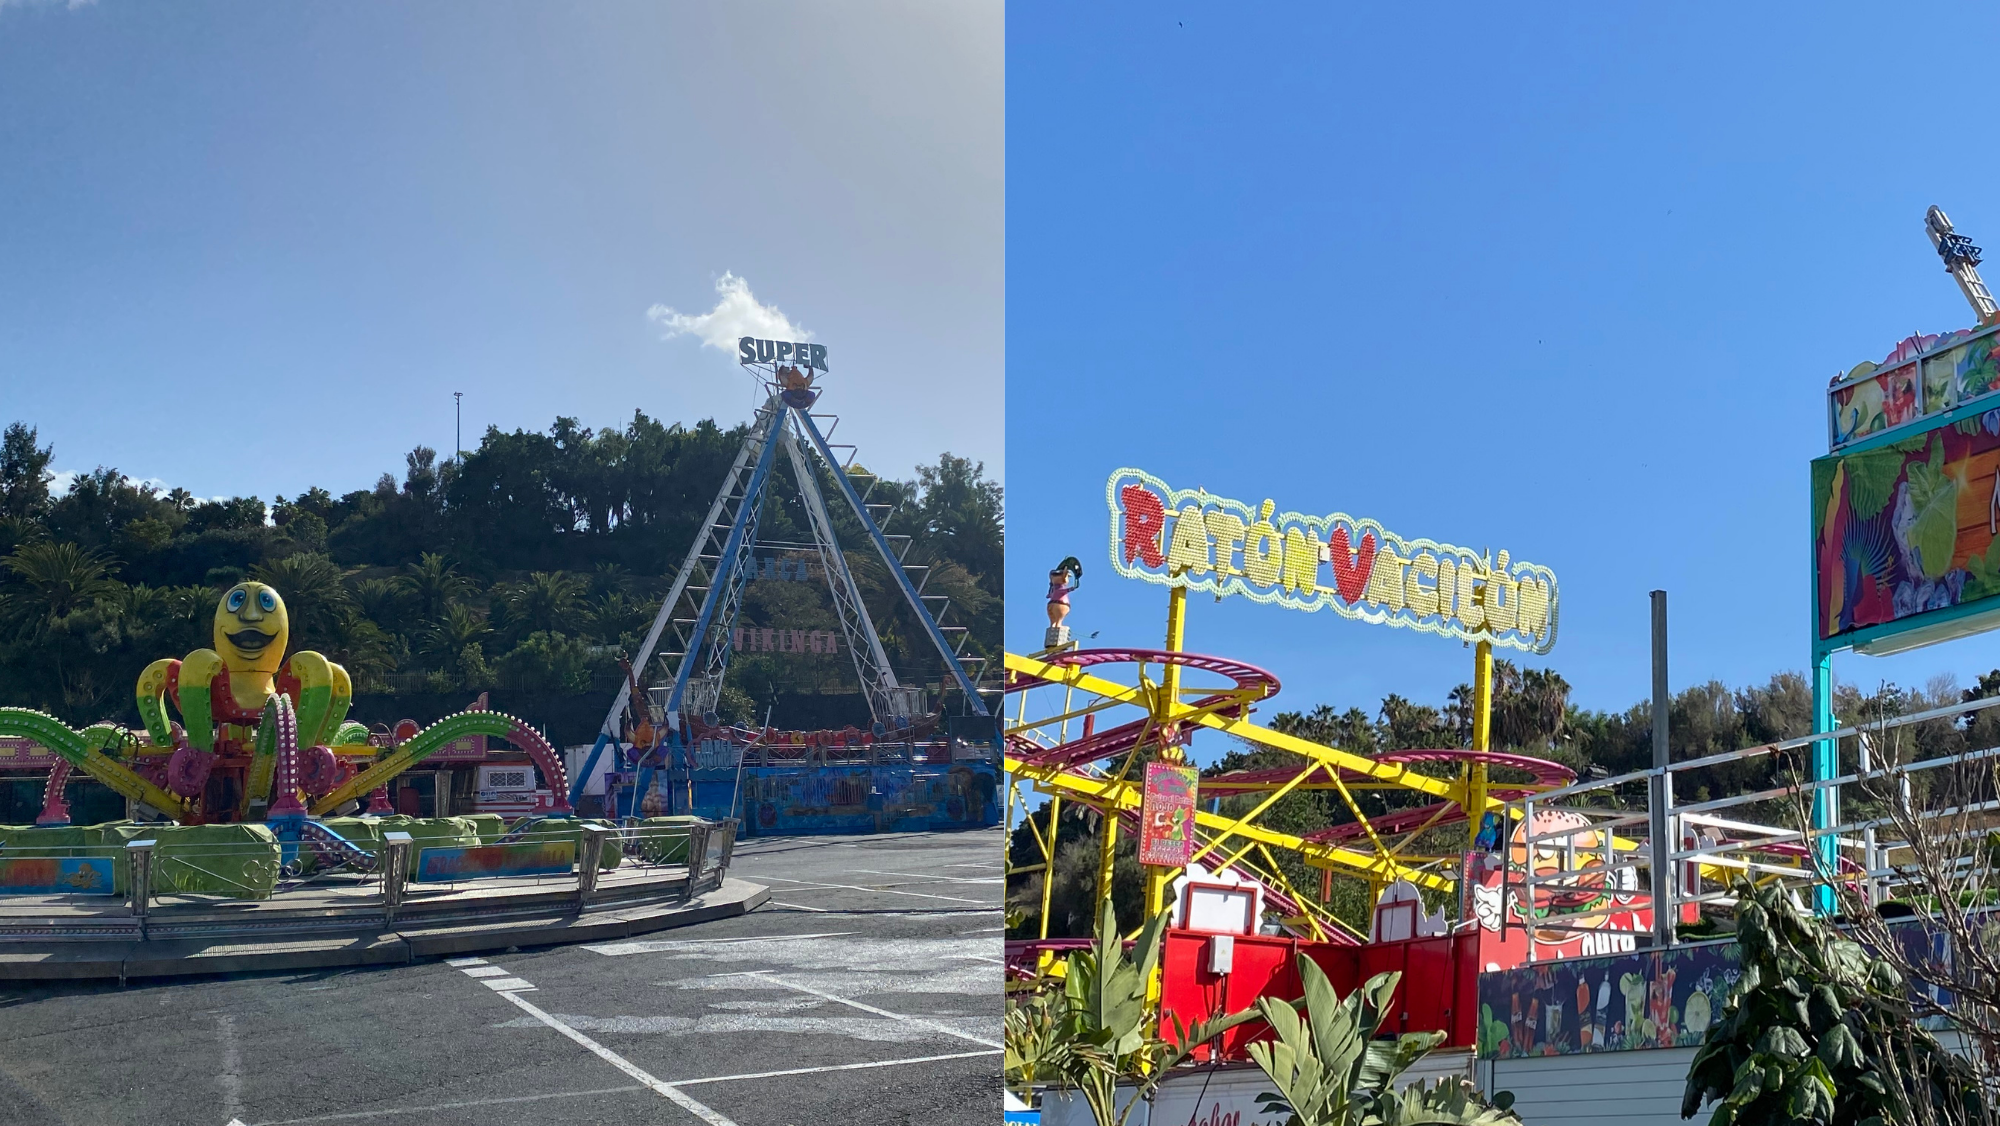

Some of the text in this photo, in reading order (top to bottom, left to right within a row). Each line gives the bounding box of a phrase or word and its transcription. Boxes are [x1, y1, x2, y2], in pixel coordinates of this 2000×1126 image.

[739, 336, 829, 372] SUPER
[1121, 484, 1549, 641] RATÓN VACILÓN
[733, 627, 838, 654] VIKINGA
[1150, 801, 1175, 813] ROJO
